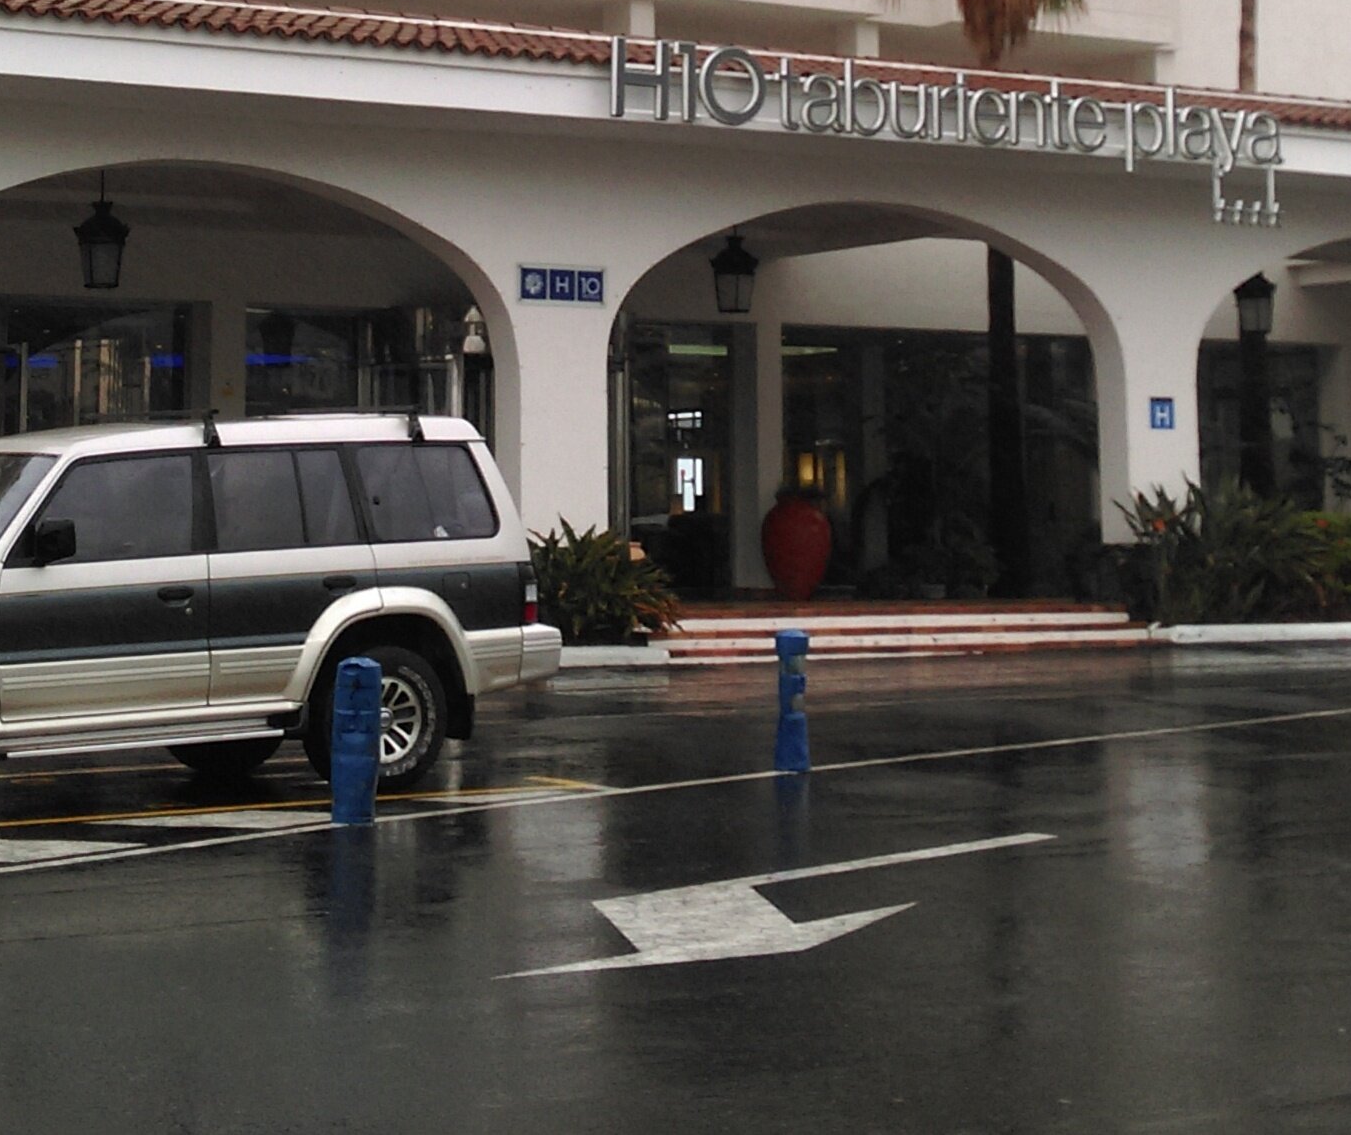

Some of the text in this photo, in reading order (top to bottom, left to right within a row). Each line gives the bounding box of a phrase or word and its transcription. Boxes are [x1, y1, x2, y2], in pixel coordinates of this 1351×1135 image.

[609, 35, 1284, 174] H10 taburiente playa
[1155, 405, 1170, 426] H
